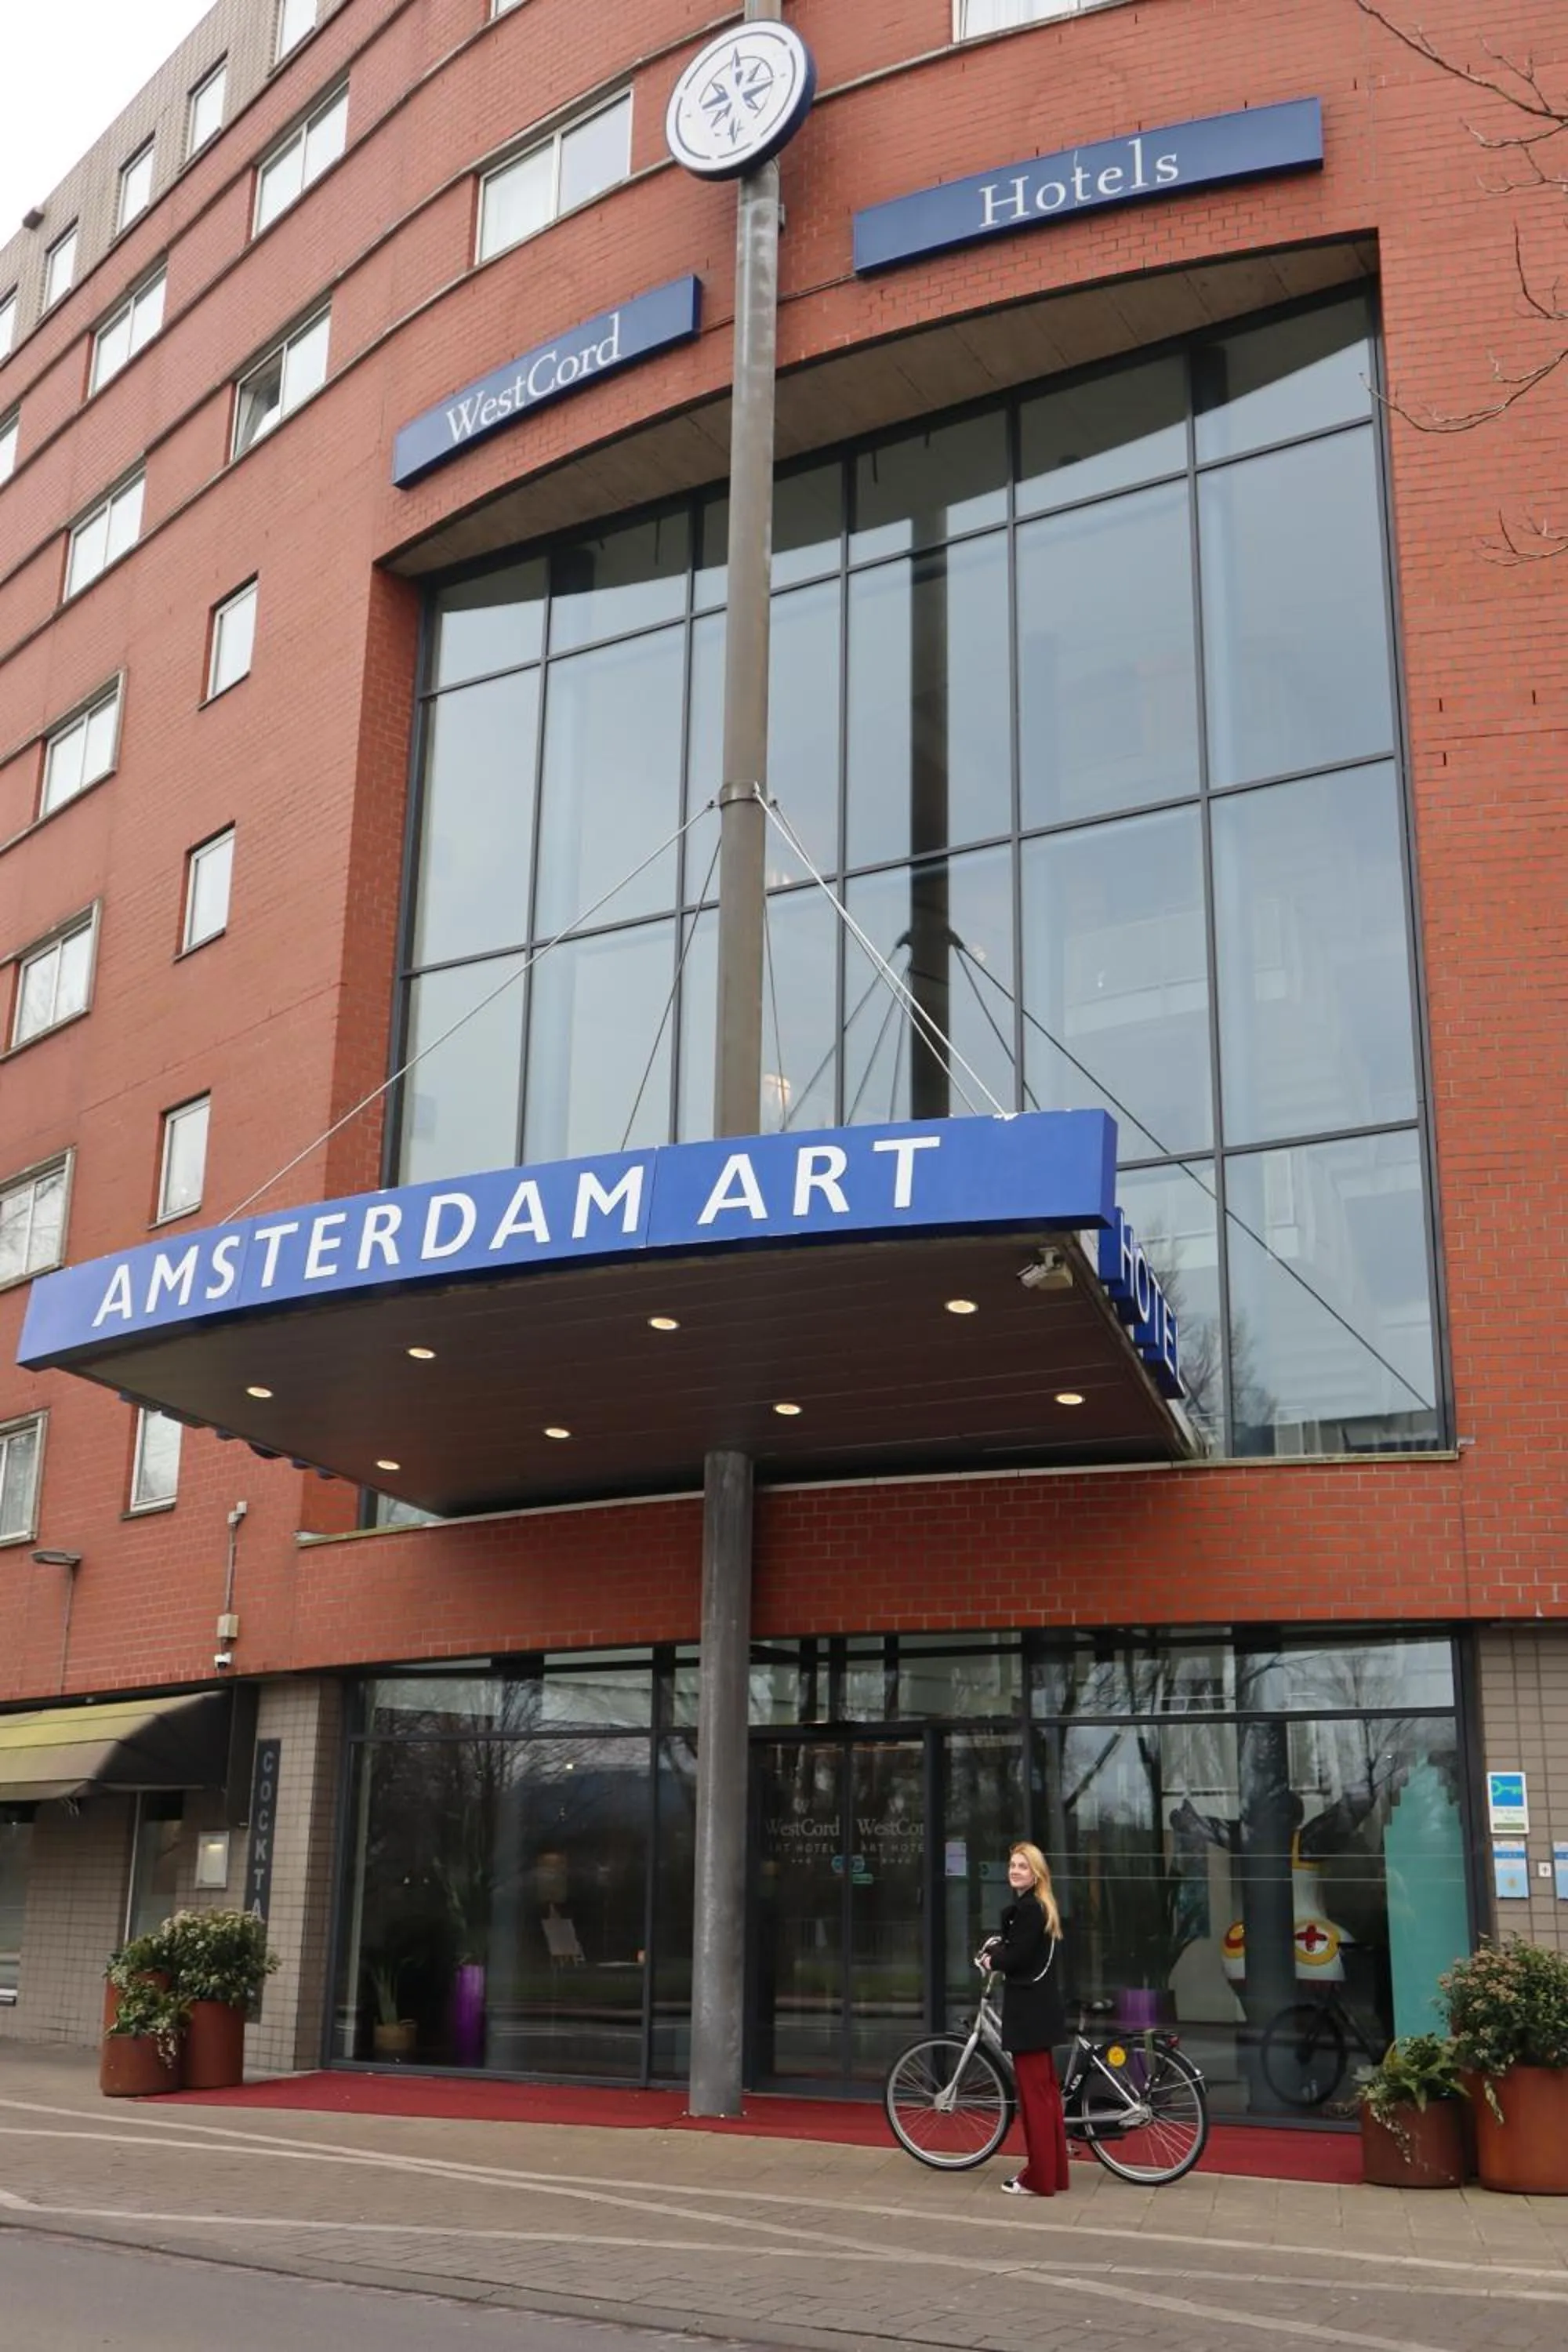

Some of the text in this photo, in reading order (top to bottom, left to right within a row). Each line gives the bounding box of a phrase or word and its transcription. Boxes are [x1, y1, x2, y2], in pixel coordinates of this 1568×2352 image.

[978, 137, 1180, 228] Hotels
[445, 311, 622, 443] WestCord
[90, 1135, 942, 1328] AMSTERDAM ART
[1112, 1207, 1186, 1399] HOTEL
[250, 1750, 275, 1924] COCKTA
[764, 1815, 840, 1837] WestCord
[891, 1842, 926, 1853] HOTE
